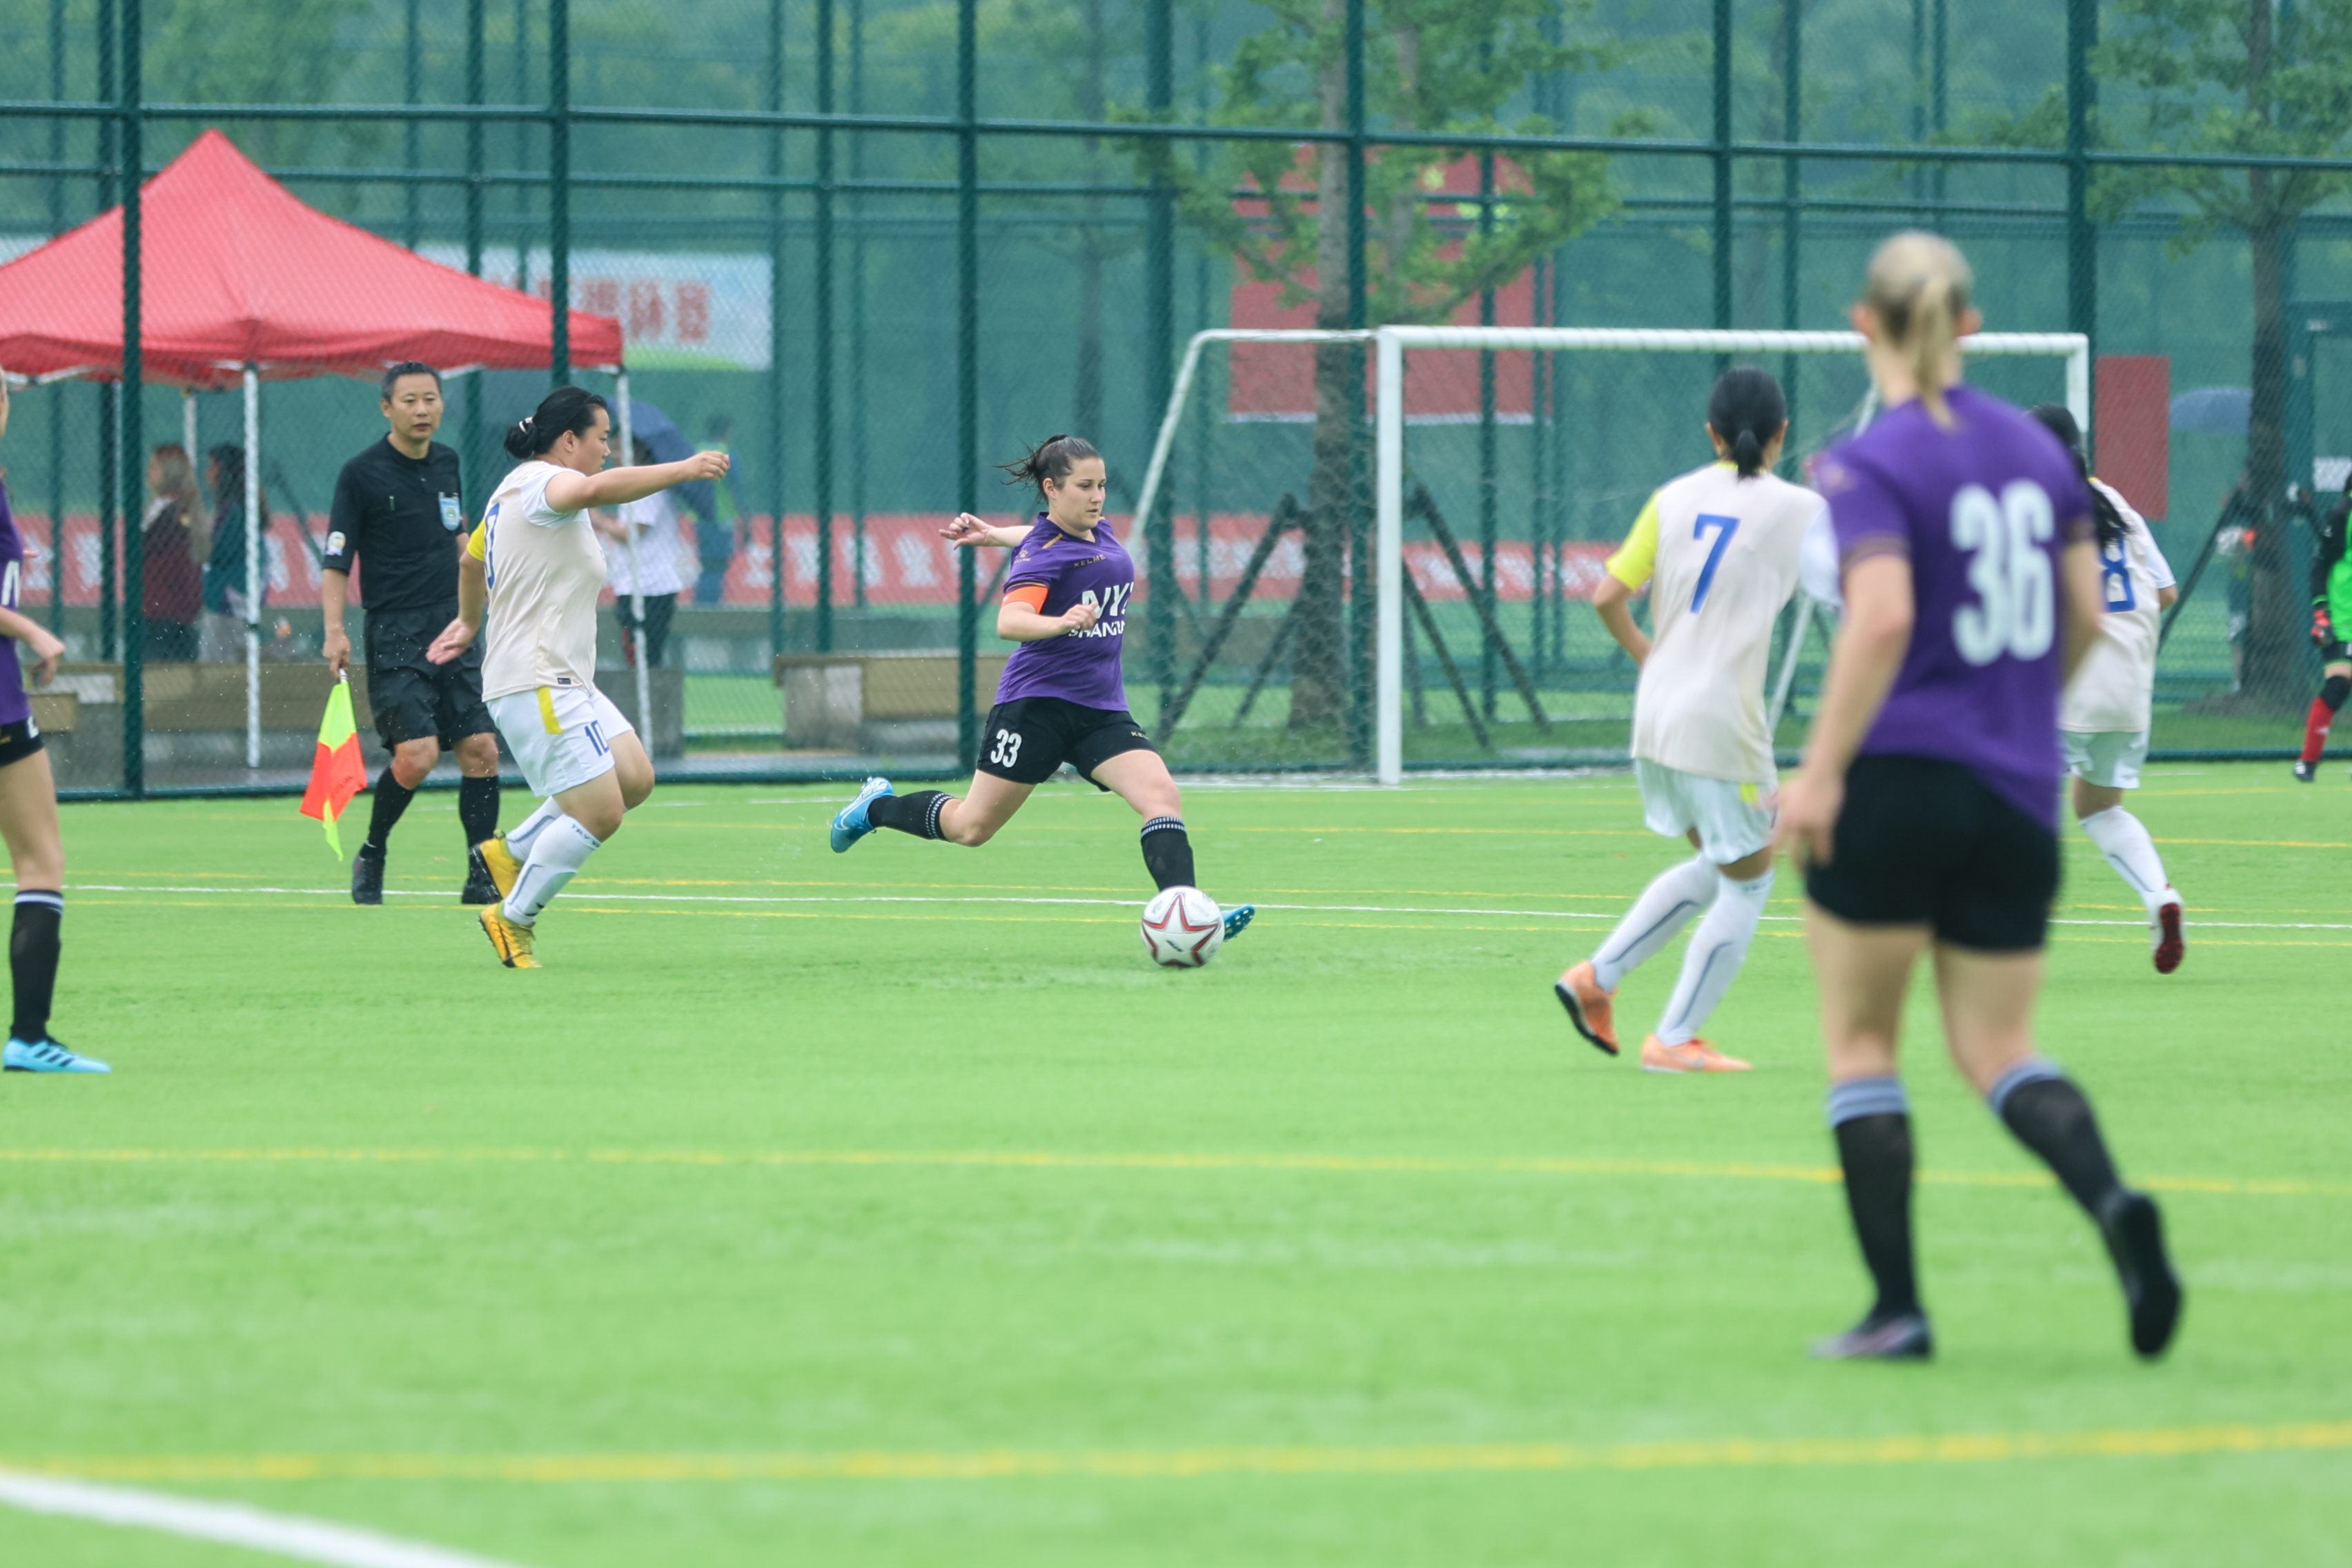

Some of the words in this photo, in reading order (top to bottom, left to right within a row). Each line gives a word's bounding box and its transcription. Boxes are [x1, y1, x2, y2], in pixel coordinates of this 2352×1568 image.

[1074, 554, 1106, 567] KELME
[1690, 513, 1741, 614] 7
[1950, 478, 2055, 665] 36
[2100, 529, 2135, 612] 8
[585, 720, 609, 756] 10
[990, 729, 1021, 767] 33
